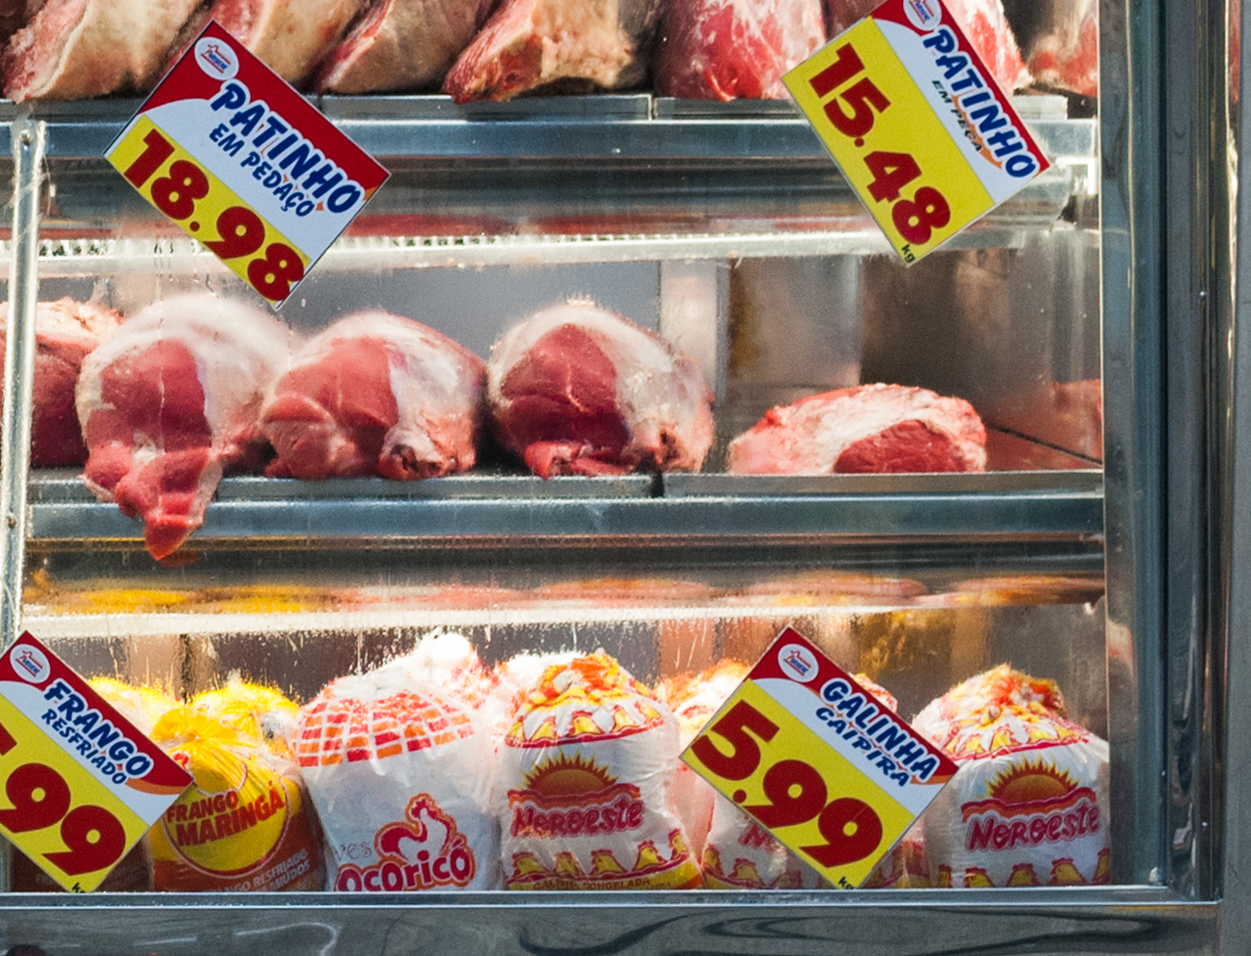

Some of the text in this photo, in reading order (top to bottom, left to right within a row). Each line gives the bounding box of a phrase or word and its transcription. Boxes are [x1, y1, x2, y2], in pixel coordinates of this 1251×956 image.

[923, 29, 1036, 178] PATINHO
[932, 80, 953, 103] EM
[209, 123, 315, 217] EM PEDAÇO
[210, 83, 361, 213] PATINHO
[809, 42, 951, 245] 15.48
[124, 128, 304, 301] 18.98
[901, 244, 916, 263] kg
[41, 709, 127, 784] RESFRIADO
[44, 682, 152, 776] FRANGO
[816, 707, 911, 786] CAIPIRA
[823, 681, 937, 781] GALINHA
[167, 790, 238, 822] FRANGO
[691, 699, 883, 869] 5.99
